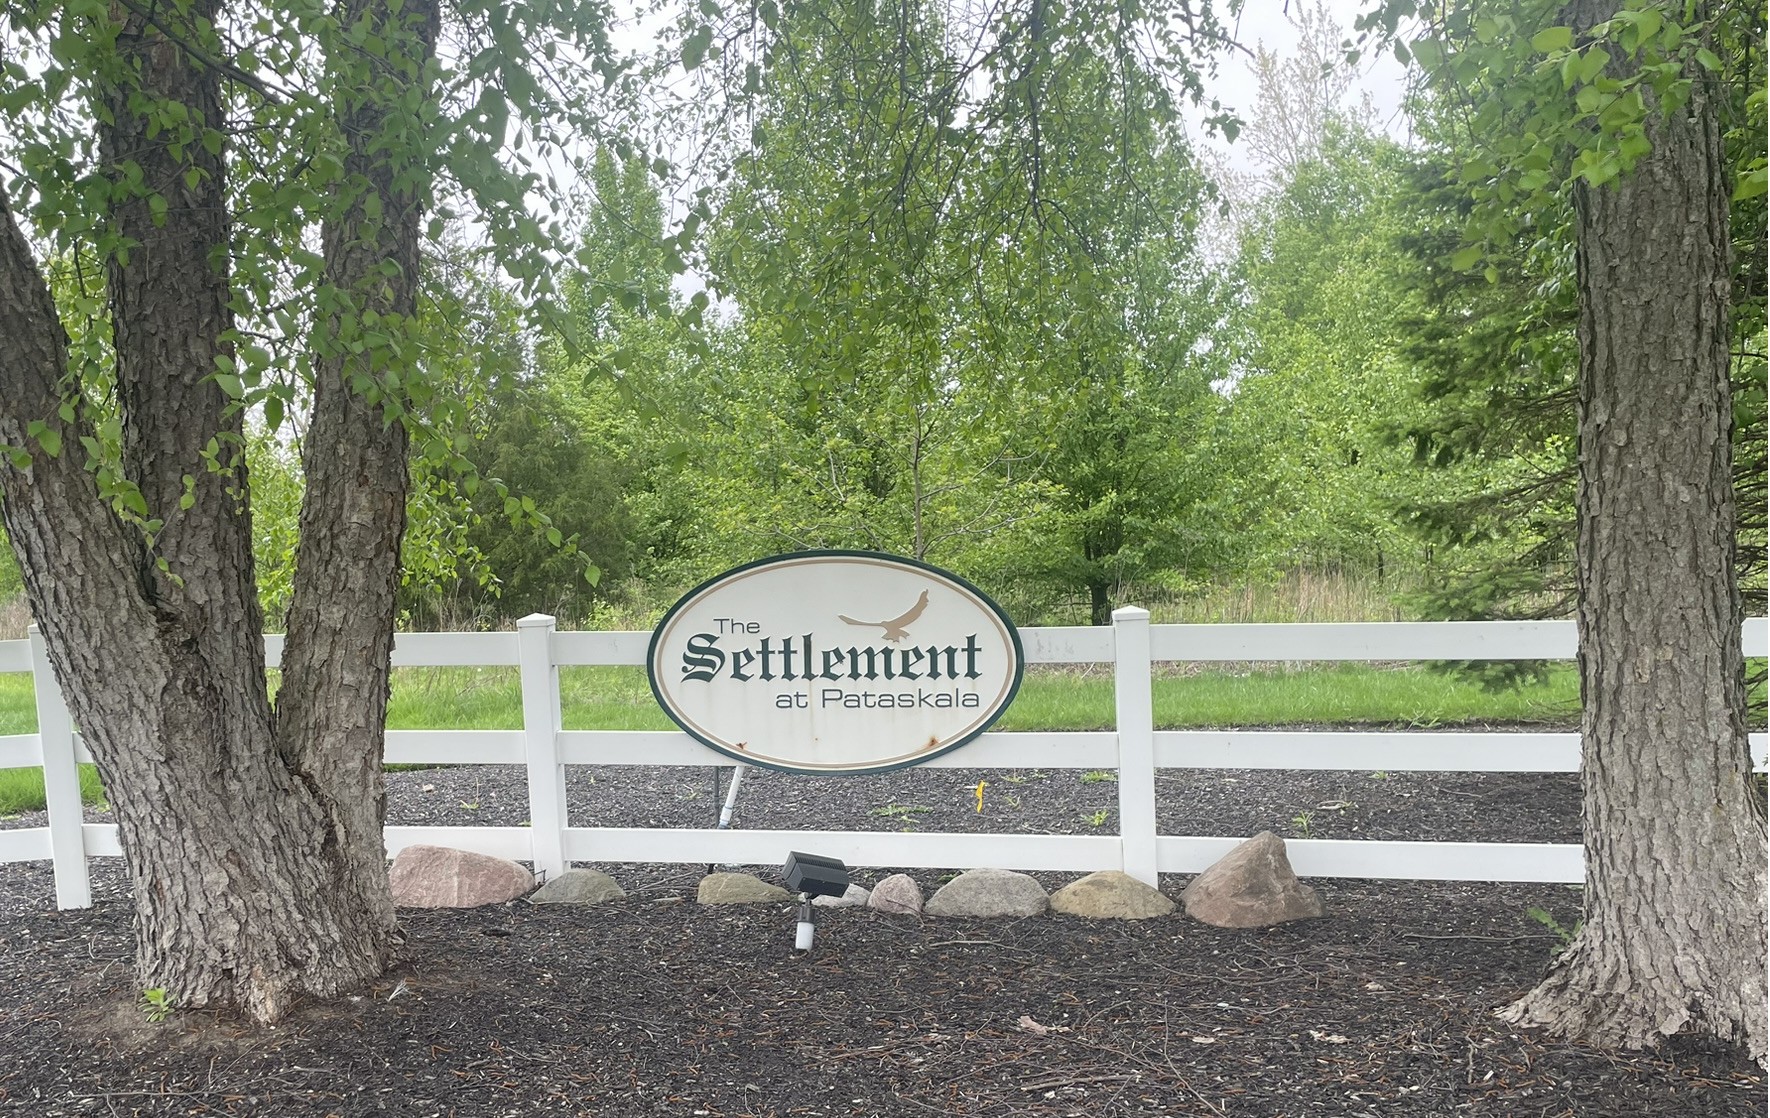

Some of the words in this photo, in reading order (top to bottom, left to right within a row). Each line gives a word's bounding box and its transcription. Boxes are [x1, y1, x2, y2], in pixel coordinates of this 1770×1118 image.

[713, 618, 760, 634] The
[681, 632, 982, 683] Settlement
[775, 691, 808, 708] at
[822, 688, 980, 708] Pataskala
